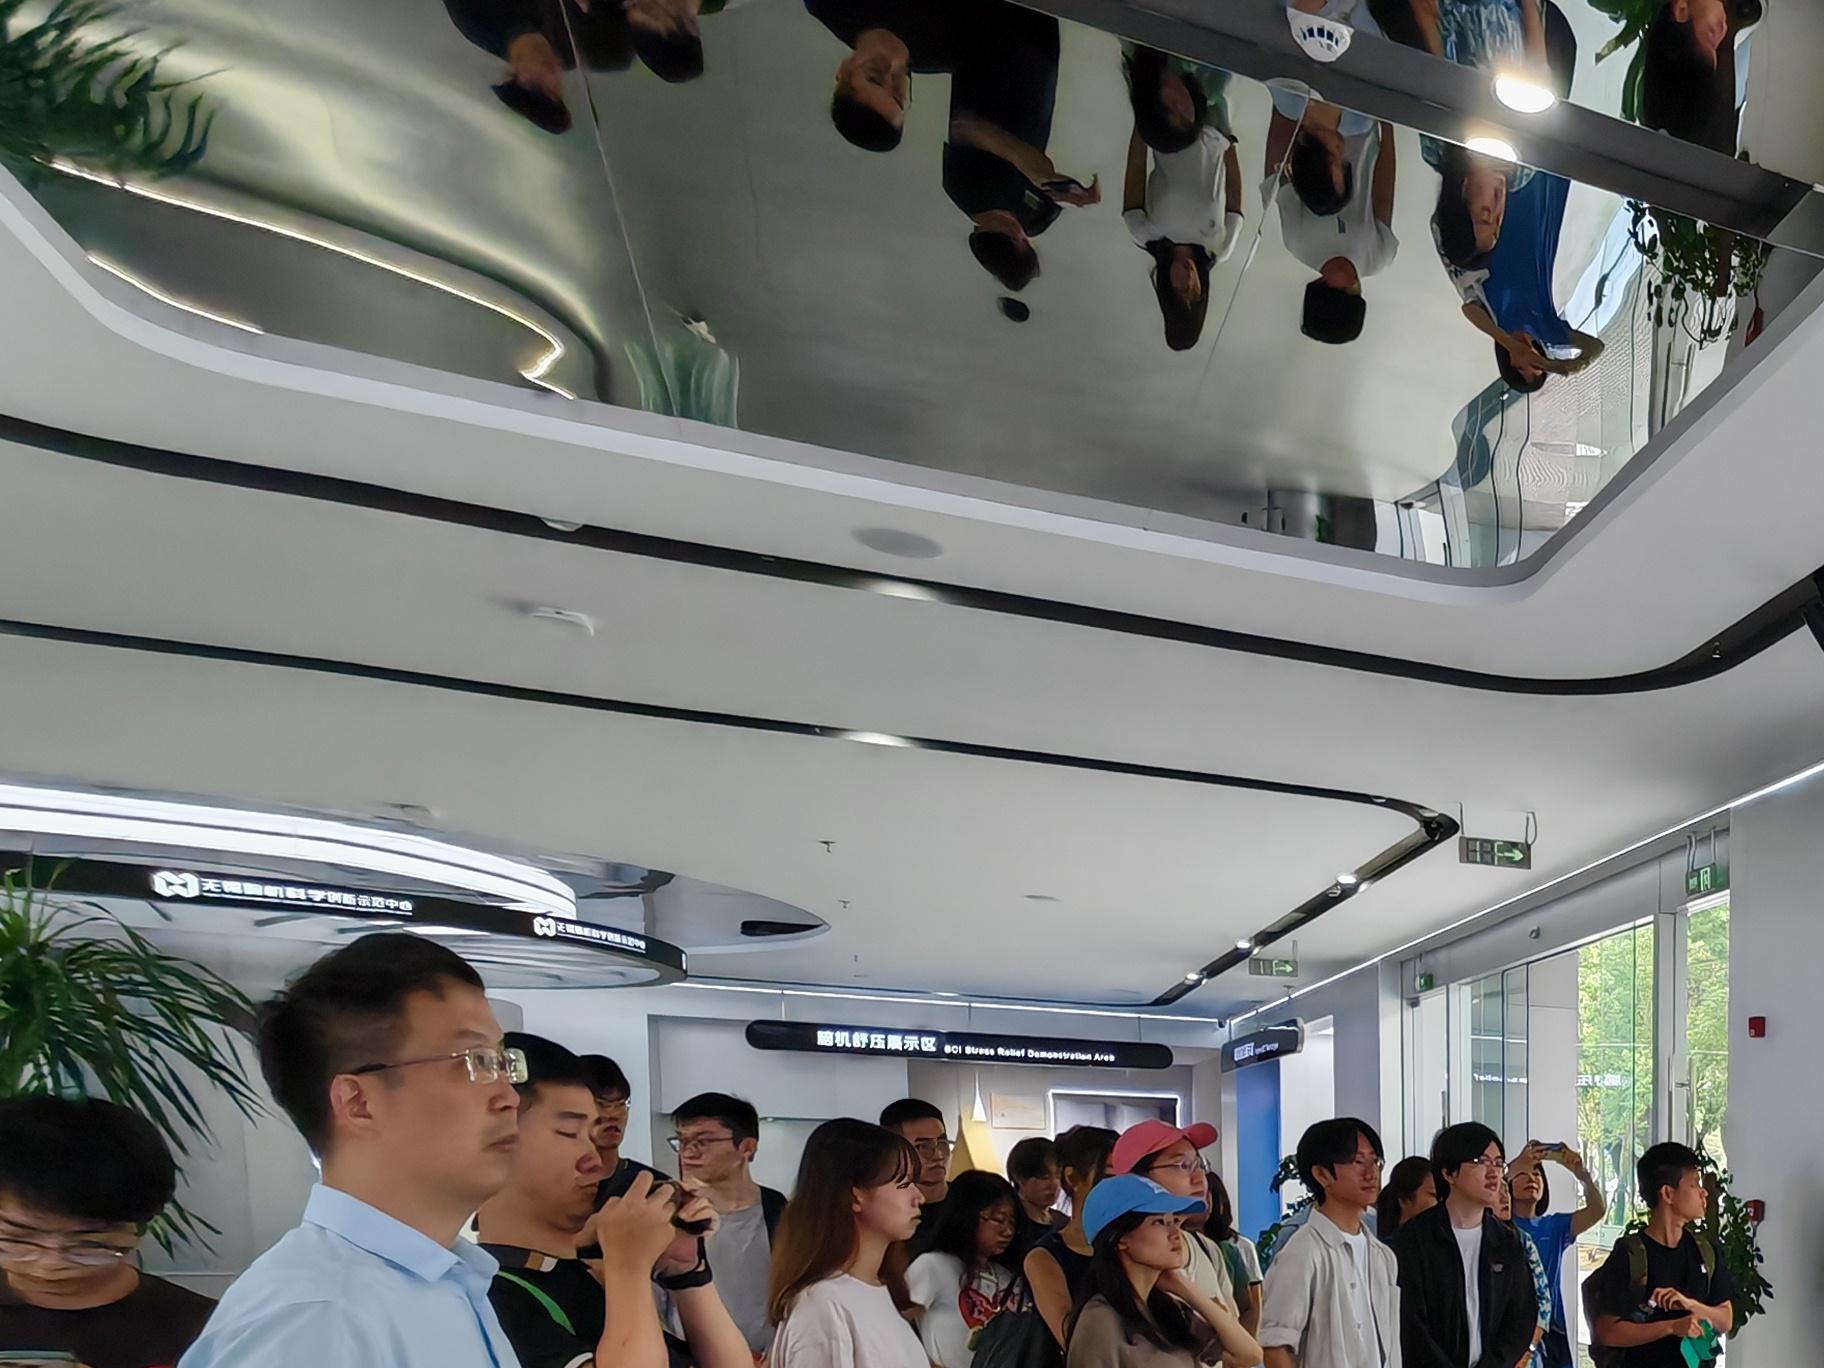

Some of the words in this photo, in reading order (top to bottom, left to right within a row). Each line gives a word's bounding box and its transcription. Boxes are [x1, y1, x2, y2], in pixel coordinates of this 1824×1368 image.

[944, 1045, 962, 1054] BCI
[998, 1047, 1025, 1058] Relief
[1027, 1049, 1092, 1061] Demonstration
[1094, 1053, 1116, 1062] Area
